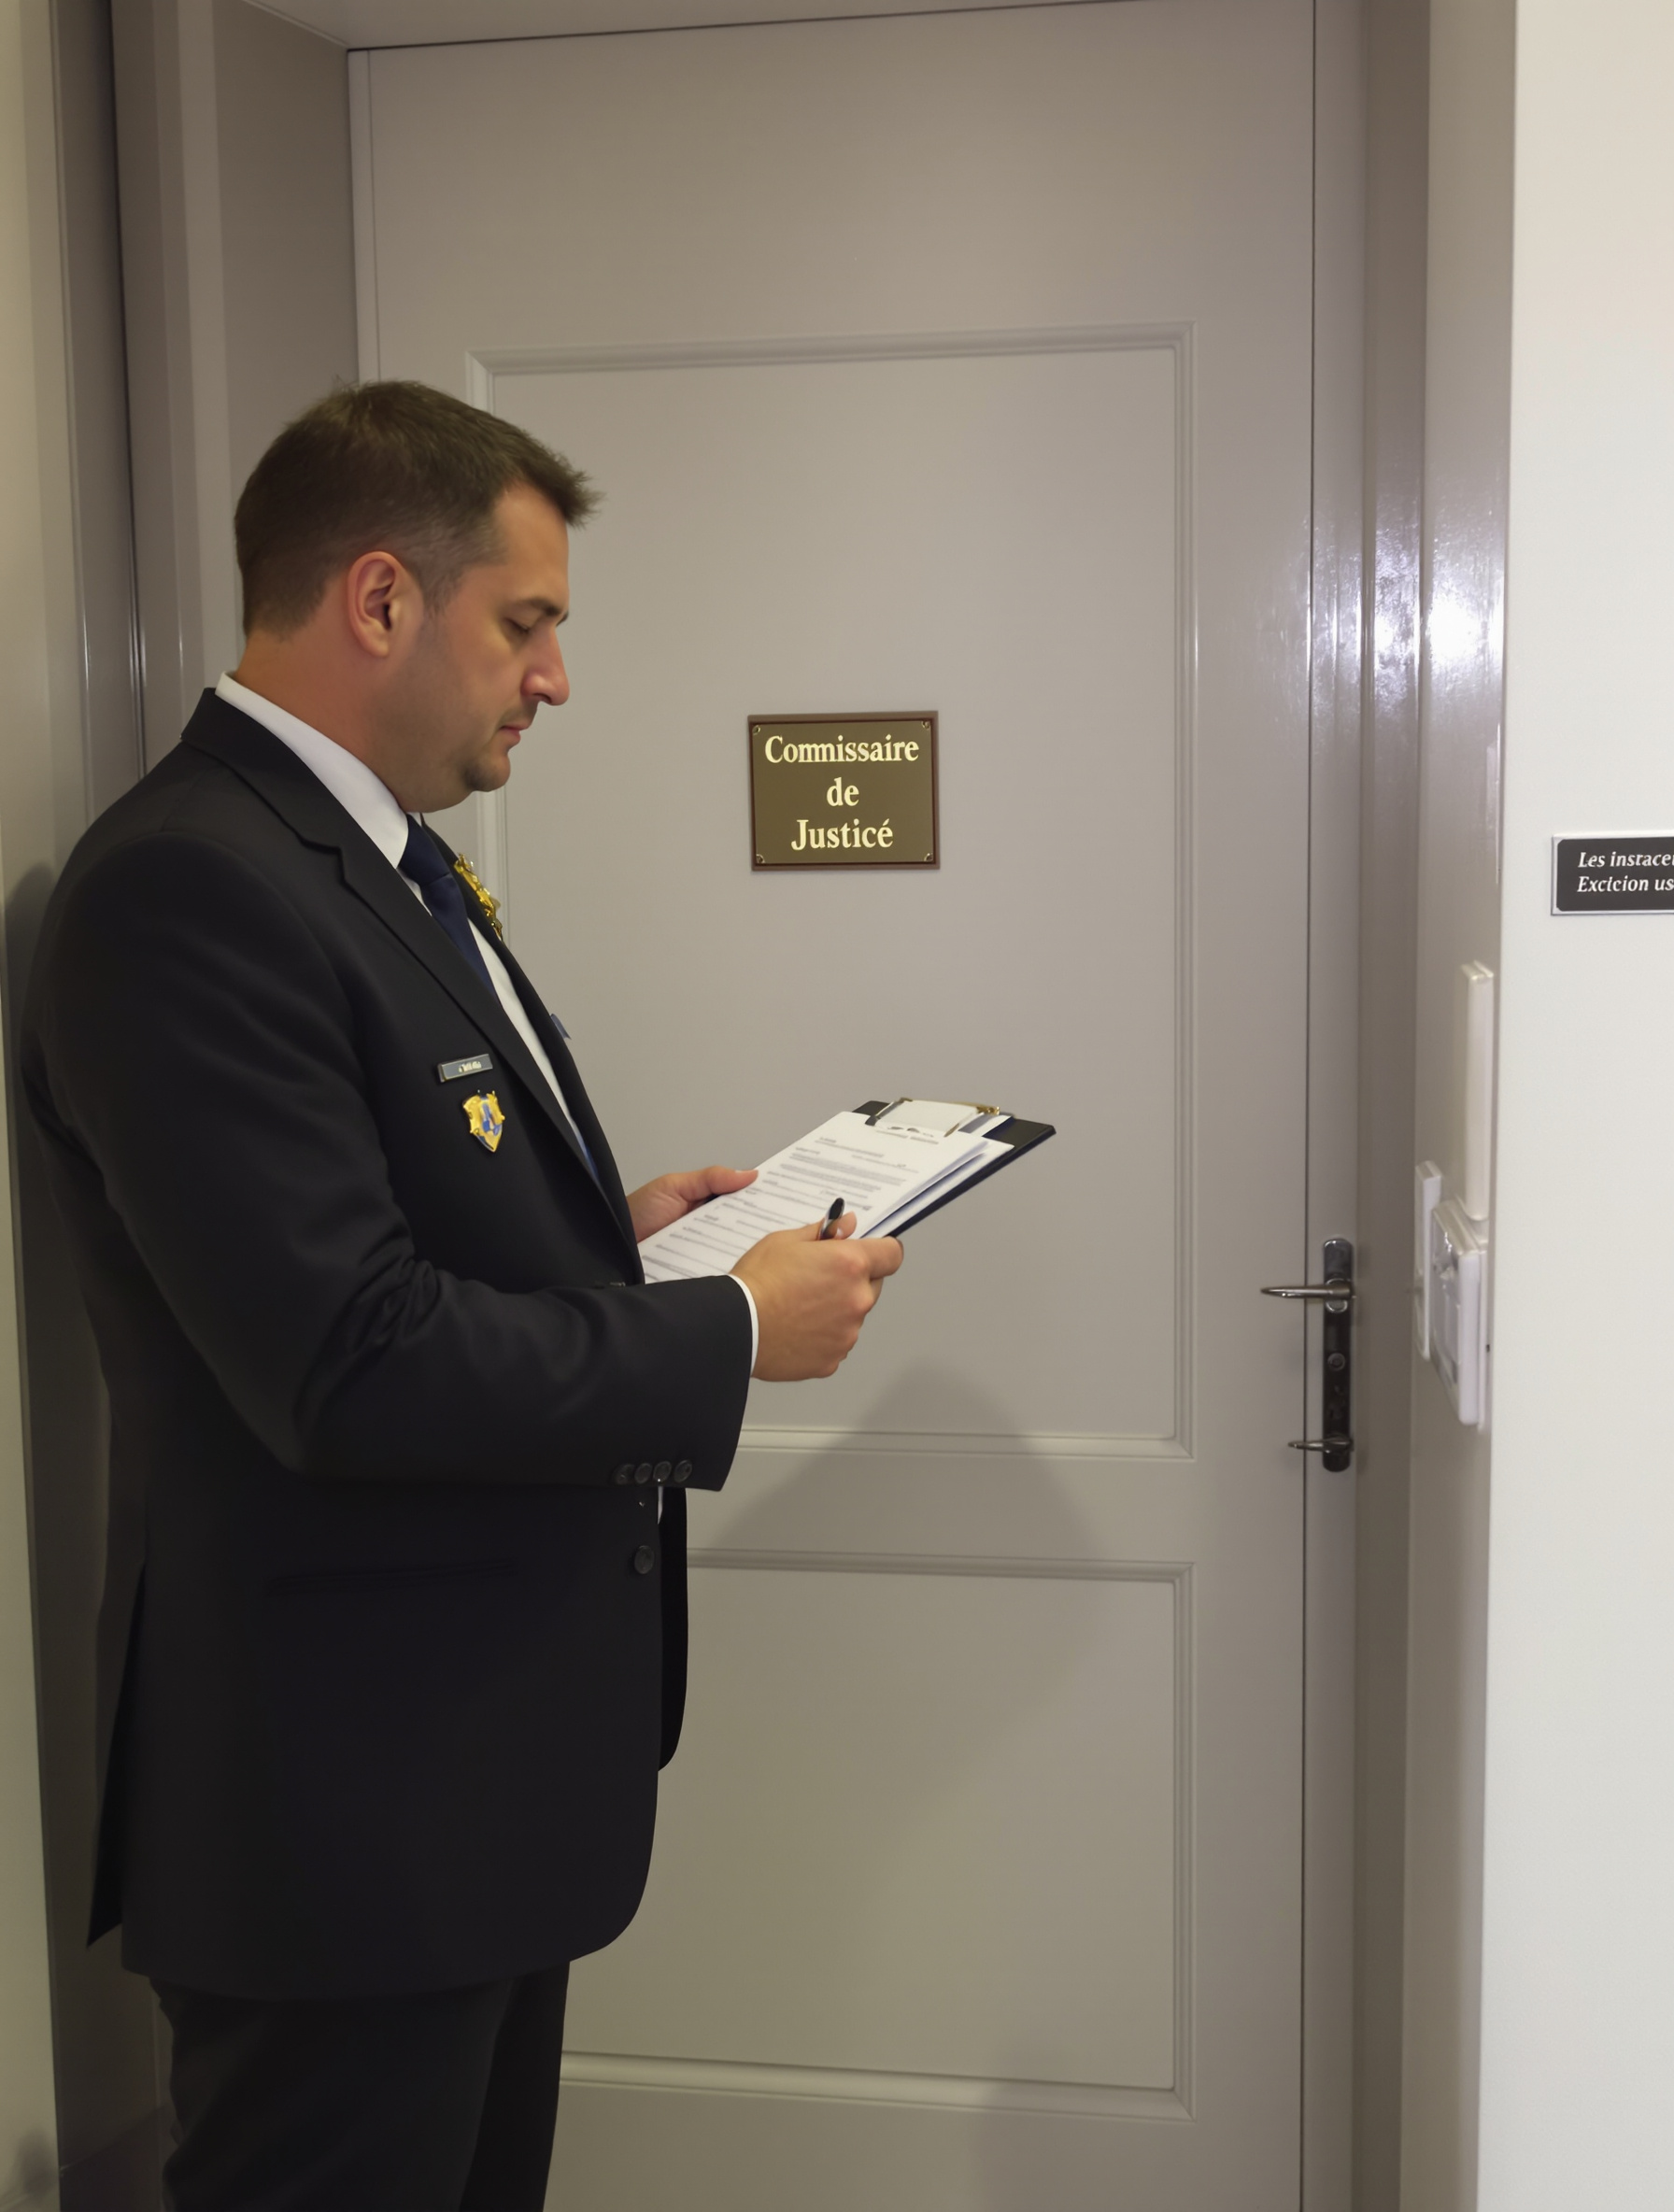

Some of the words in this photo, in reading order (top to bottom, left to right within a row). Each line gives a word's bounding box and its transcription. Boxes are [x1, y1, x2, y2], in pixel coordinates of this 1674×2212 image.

[764, 733, 920, 763] Commissaire
[826, 776, 860, 807] de
[790, 818, 894, 851] Justicé
[1578, 852, 1606, 868] Les
